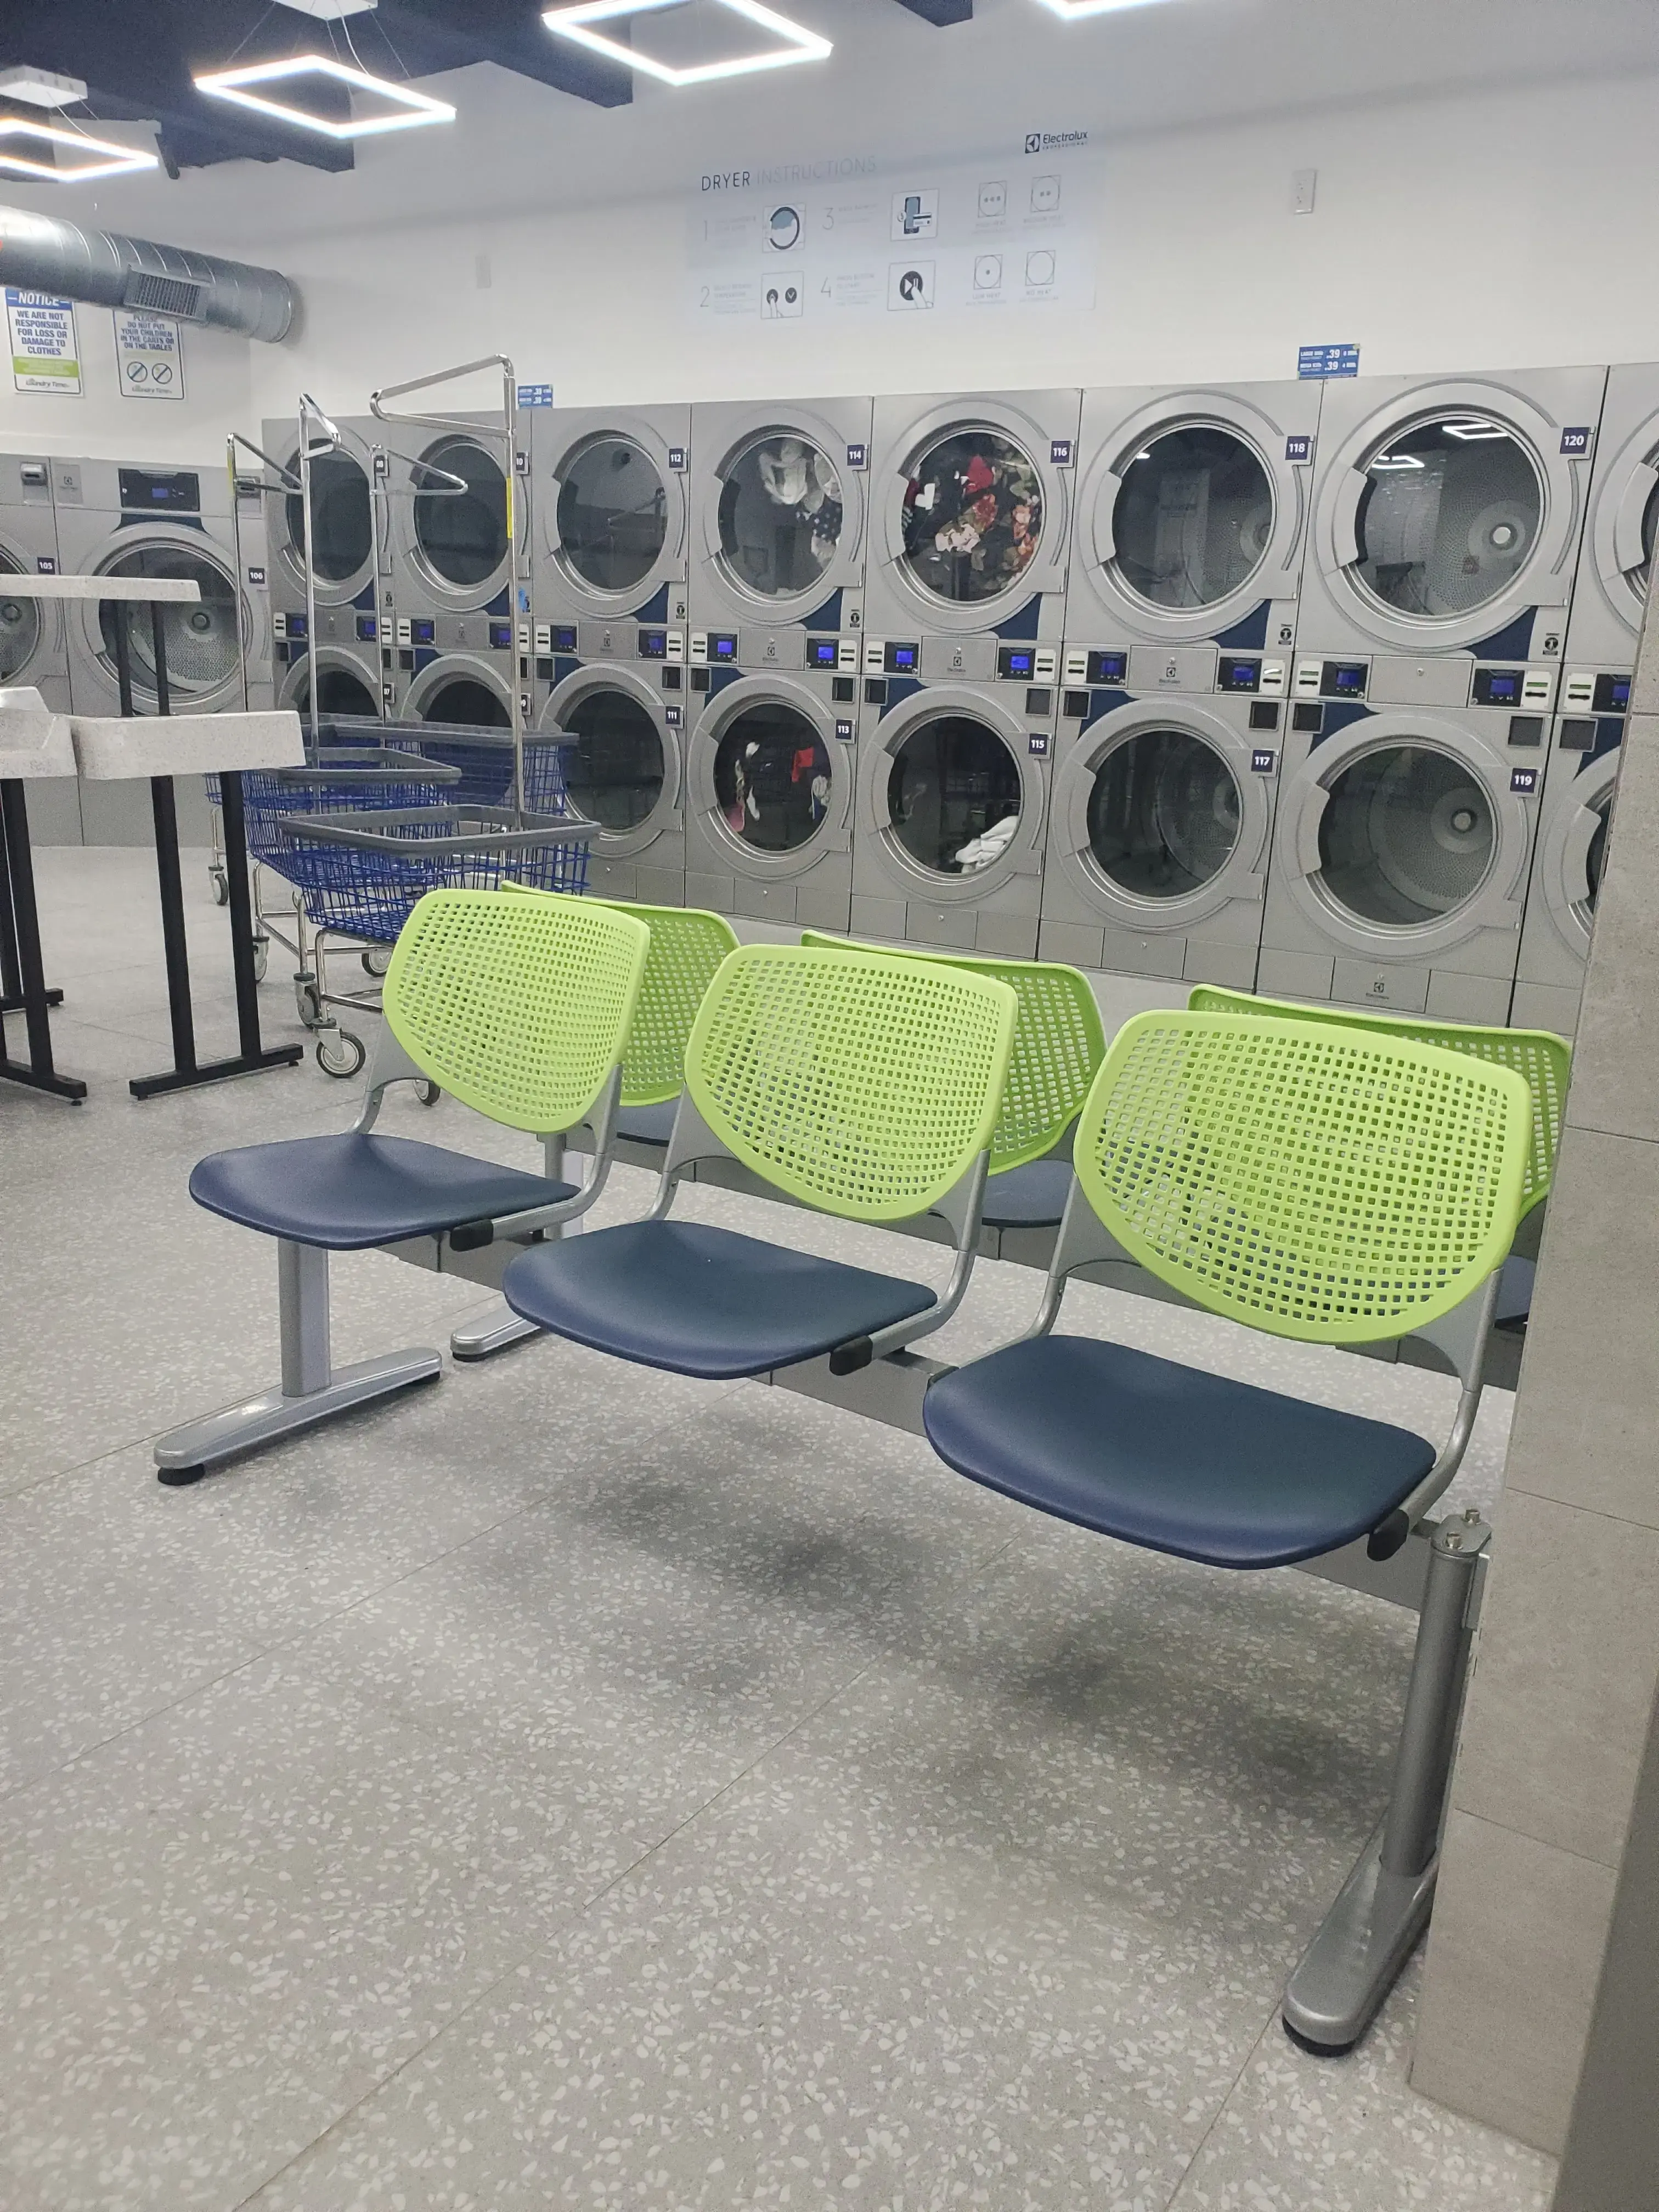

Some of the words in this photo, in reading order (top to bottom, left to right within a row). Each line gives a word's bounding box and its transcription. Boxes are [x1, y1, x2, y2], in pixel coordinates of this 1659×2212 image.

[1043, 131, 1088, 143] Electrolux
[701, 171, 751, 191] DRYER
[757, 156, 876, 185] INSTRUCTIONS
[822, 207, 834, 230] 3
[821, 276, 831, 297] 4
[18, 292, 60, 306] NOTICE
[699, 286, 710, 307] 2
[17, 309, 30, 318] WE
[31, 311, 47, 319] ARE
[49, 312, 64, 320] NOT
[15, 319, 68, 330] RESPONSIBLE
[35, 329, 54, 337] LOSS
[21, 337, 54, 346] DAMAGE
[27, 346, 61, 356] CLOTHES
[1326, 349, 1340, 359] .39
[1324, 361, 1339, 371] .39
[1564, 435, 1584, 446] 120
[1053, 447, 1068, 457] 116
[1289, 443, 1306, 453] 118
[670, 454, 681, 462] 112
[849, 450, 862, 460] 114
[40, 561, 53, 569] 105
[250, 572, 263, 580] 106
[667, 710, 677, 720] 111
[838, 725, 849, 734] 113
[1031, 739, 1045, 749] 115
[1255, 755, 1271, 766] 117
[1514, 774, 1532, 786] 119
